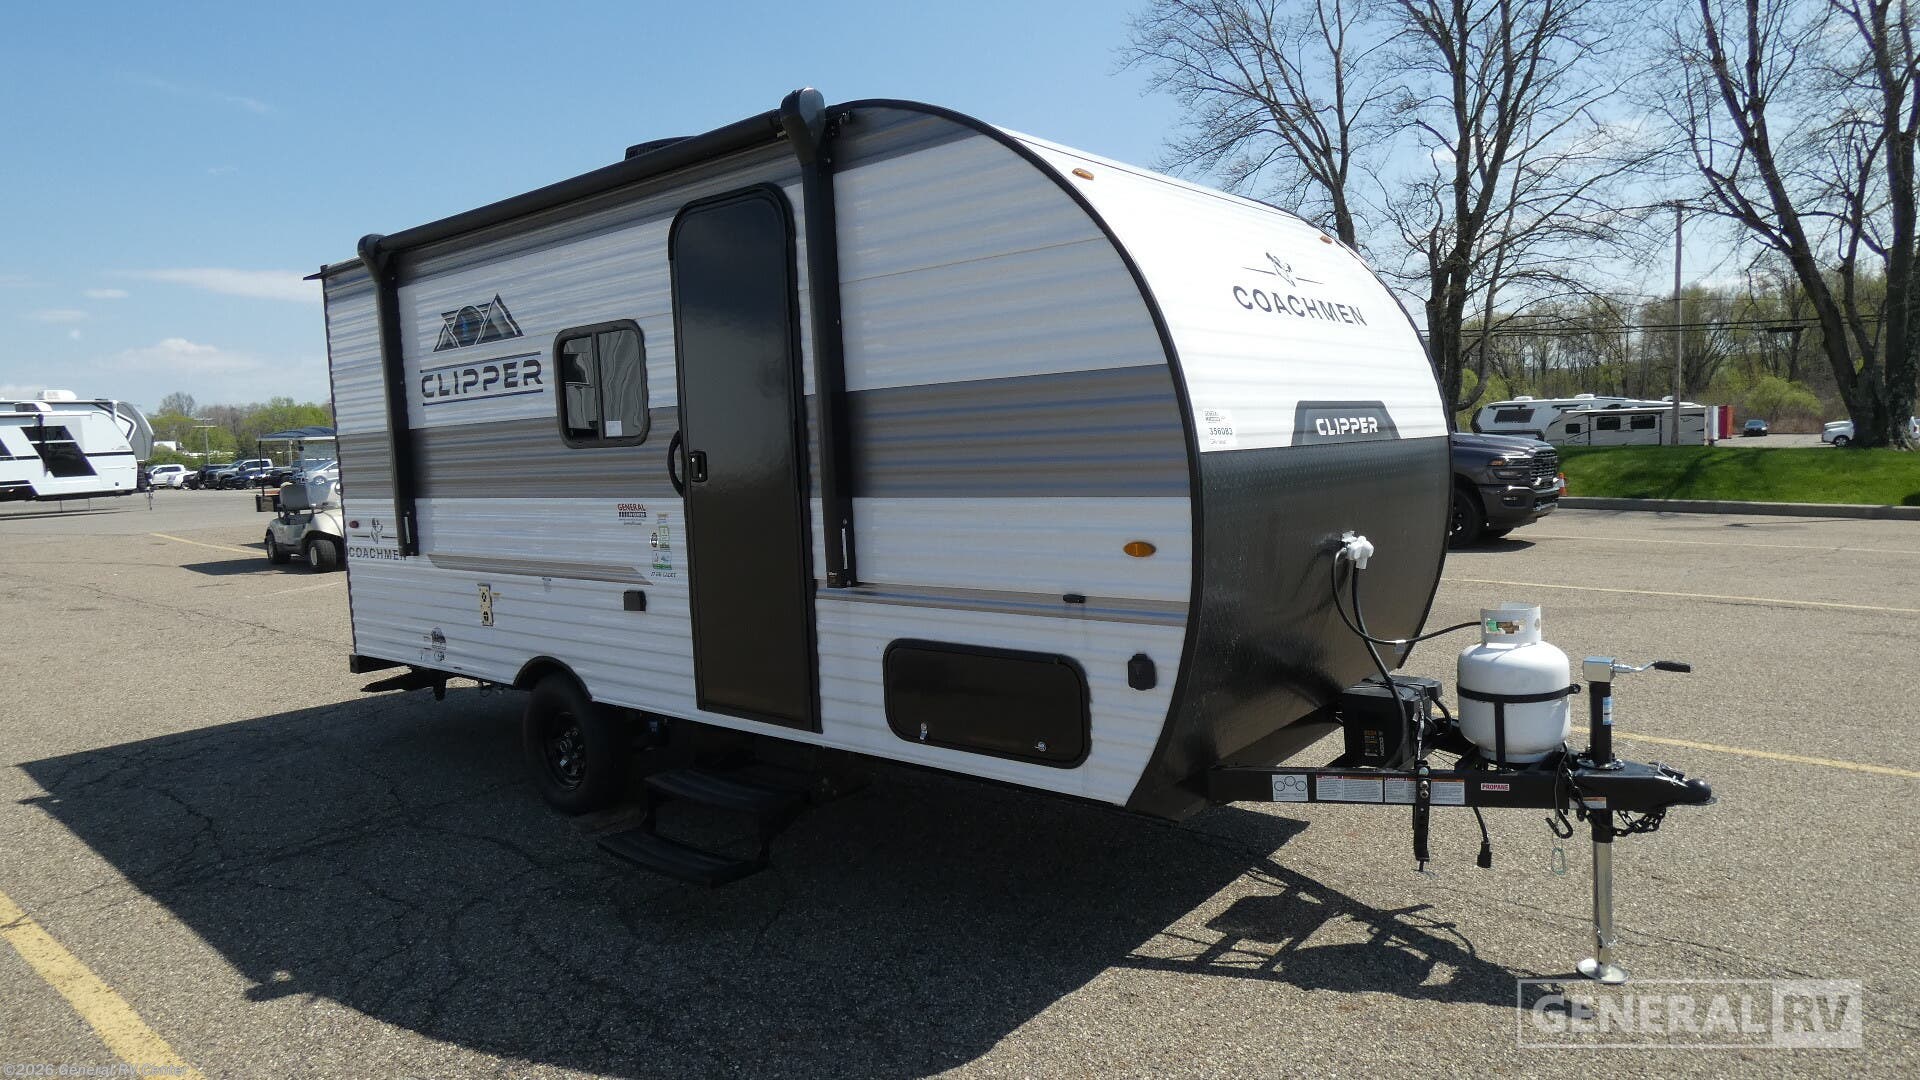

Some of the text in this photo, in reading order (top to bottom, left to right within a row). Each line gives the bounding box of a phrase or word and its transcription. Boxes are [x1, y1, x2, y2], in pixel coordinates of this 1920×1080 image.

[1233, 285, 1368, 326] COACHMEN
[421, 359, 543, 398] CLIPPER
[1315, 416, 1379, 436] CLIPPER
